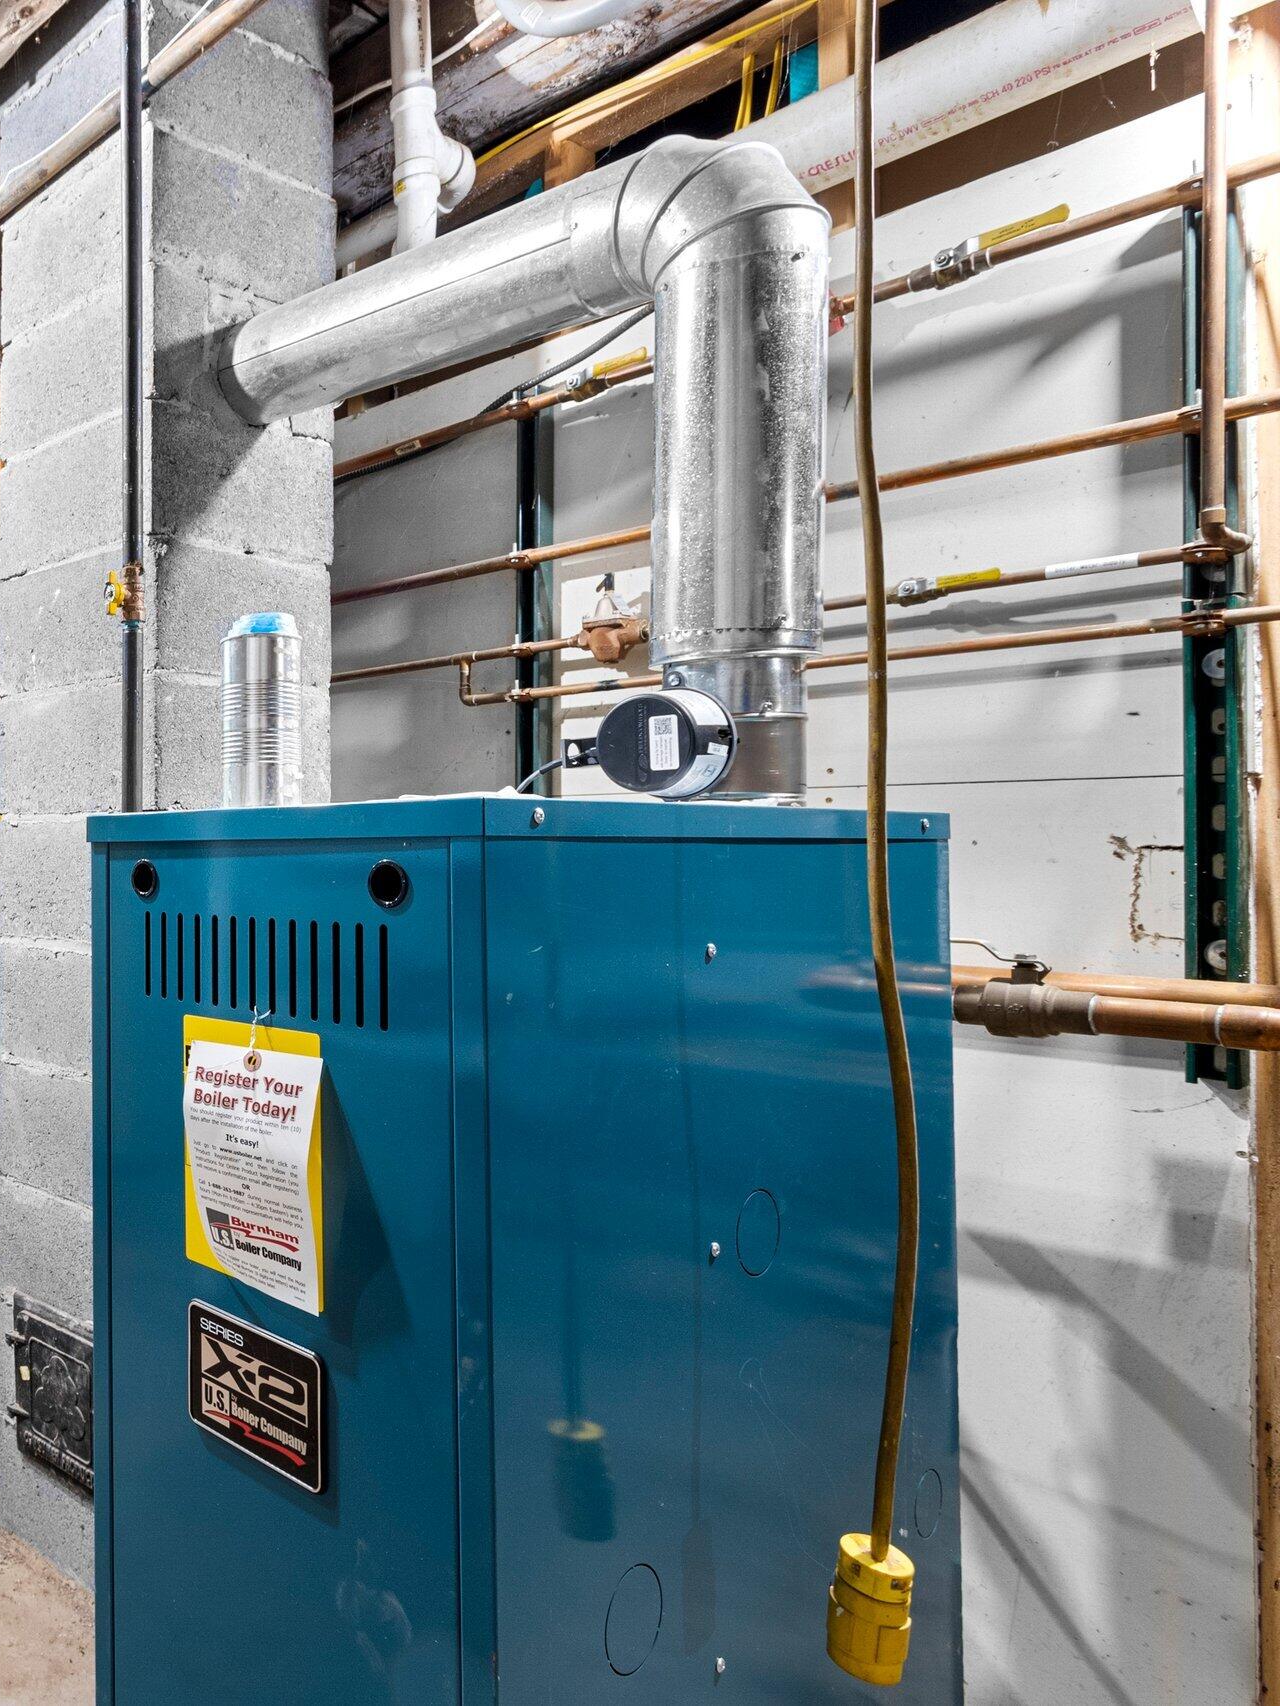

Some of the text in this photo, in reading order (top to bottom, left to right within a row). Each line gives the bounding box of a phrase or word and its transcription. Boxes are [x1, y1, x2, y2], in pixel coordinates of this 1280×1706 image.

[878, 134, 897, 148] PVC
[898, 123, 920, 138] DWV
[979, 88, 999, 104] SCH
[1001, 83, 1013, 94] 40
[1015, 74, 1032, 88] 220
[1034, 64, 1051, 79] PSI
[195, 1066, 302, 1098] Register Your
[193, 1088, 296, 1124] Boiler Today!
[200, 1108, 213, 1116] should
[245, 1118, 263, 1126] product
[290, 1125, 301, 1134] (10)
[220, 1120, 243, 1130] installation
[225, 1134, 259, 1149] It's easy!
[278, 1160, 288, 1168] click
[231, 1216, 299, 1244] Burnham
[211, 1226, 233, 1249] U.S.
[235, 1239, 260, 1255] Boiler
[262, 1247, 302, 1271] Company
[200, 1317, 244, 1347] SERIES
[203, 1336, 307, 1425] X-2
[205, 1383, 307, 1456] U.S. Boiler Company
